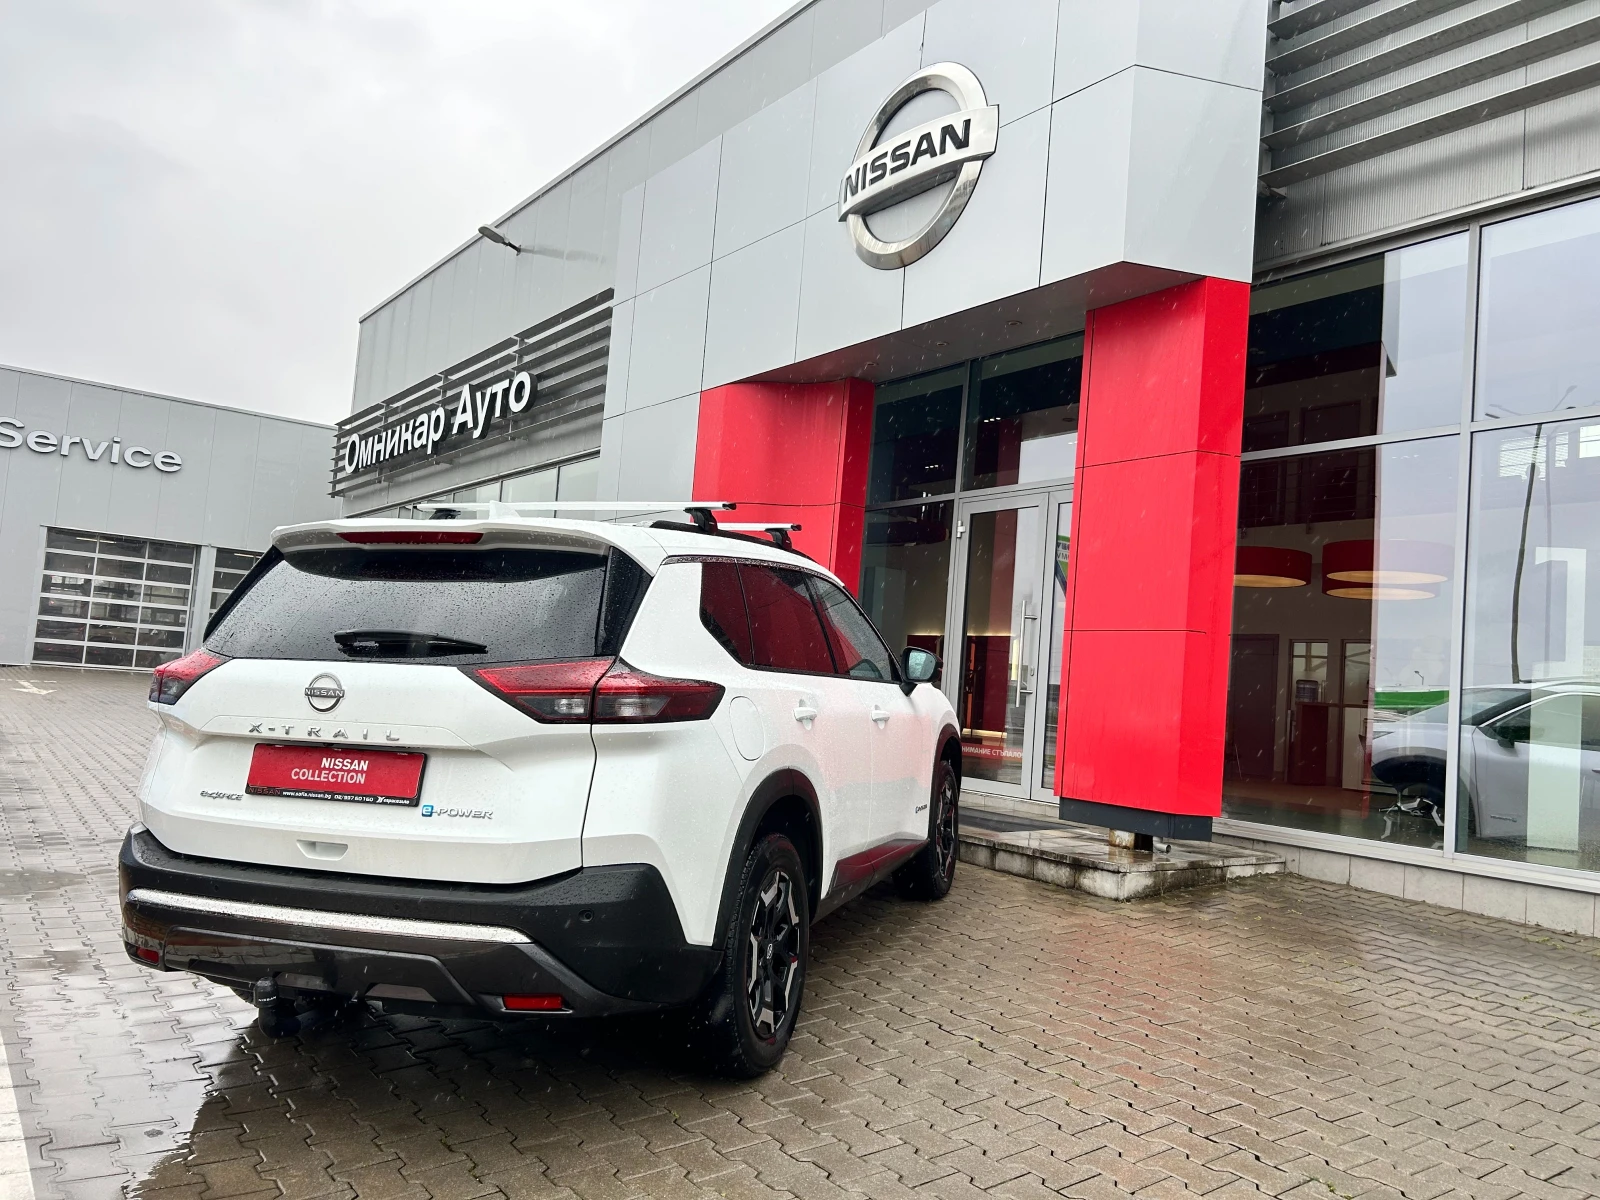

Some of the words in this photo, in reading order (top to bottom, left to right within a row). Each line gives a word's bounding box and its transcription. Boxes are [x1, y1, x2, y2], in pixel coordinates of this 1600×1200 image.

[843, 118, 971, 204] NISSAN
[345, 407, 446, 474] Омникар
[452, 371, 532, 440] Ауто
[0, 416, 183, 473] Service
[305, 688, 343, 697] NISSAN
[249, 722, 400, 742] X-TRAIL
[961, 746, 991, 755] НИМАНИЕ
[992, 749, 1024, 759] СТЪПАЛО
[321, 758, 369, 771] NISSAN
[291, 768, 366, 784] COLLECTION
[249, 787, 280, 795] NISSAN
[422, 804, 494, 820] e-POWER
